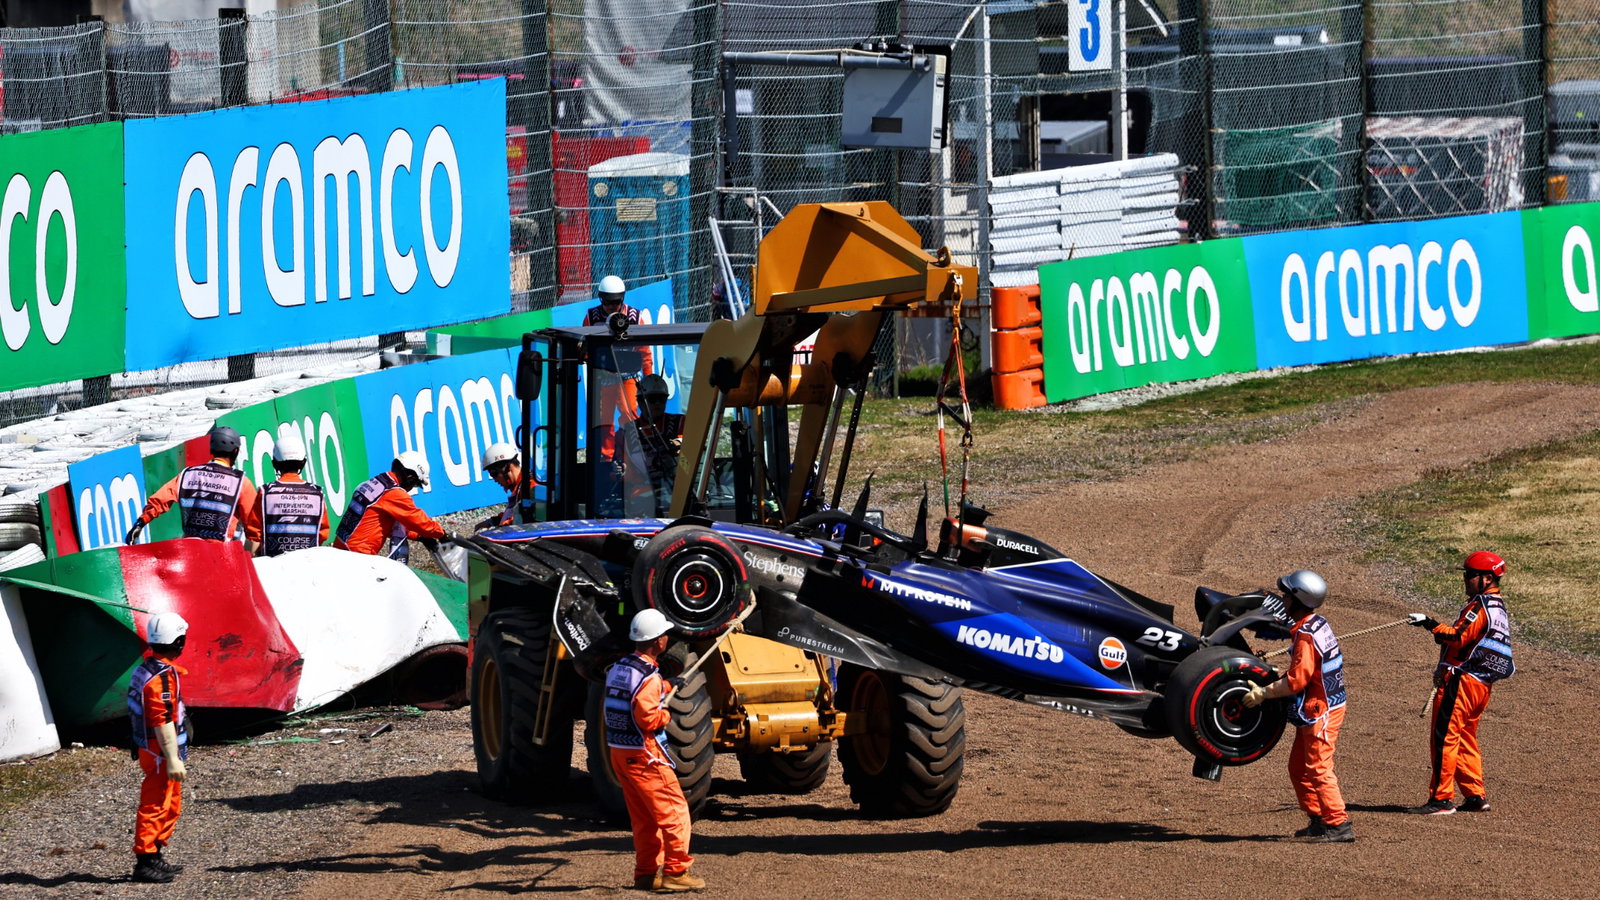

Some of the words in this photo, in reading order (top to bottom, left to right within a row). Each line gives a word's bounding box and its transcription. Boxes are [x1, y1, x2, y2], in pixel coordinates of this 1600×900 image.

[1079, 0, 1101, 62] 3
[175, 125, 463, 319] aramco
[1281, 239, 1481, 342] aramco
[1068, 265, 1220, 374] aramco
[390, 373, 521, 493] aramc
[202, 481, 231, 492] MARSHAL
[277, 536, 310, 544] COURSE
[278, 544, 310, 552] ACCESS
[996, 538, 1039, 555] DURACELL
[743, 551, 805, 578] Stephens
[880, 580, 972, 611] MYPROTEIN
[789, 634, 844, 654] PURESTREAM
[956, 625, 1064, 663] KOMATSU
[1135, 627, 1183, 651] 23
[1100, 647, 1125, 661] Gulf
[1485, 652, 1509, 668] COURSE
[1481, 660, 1507, 675] ACCESS
